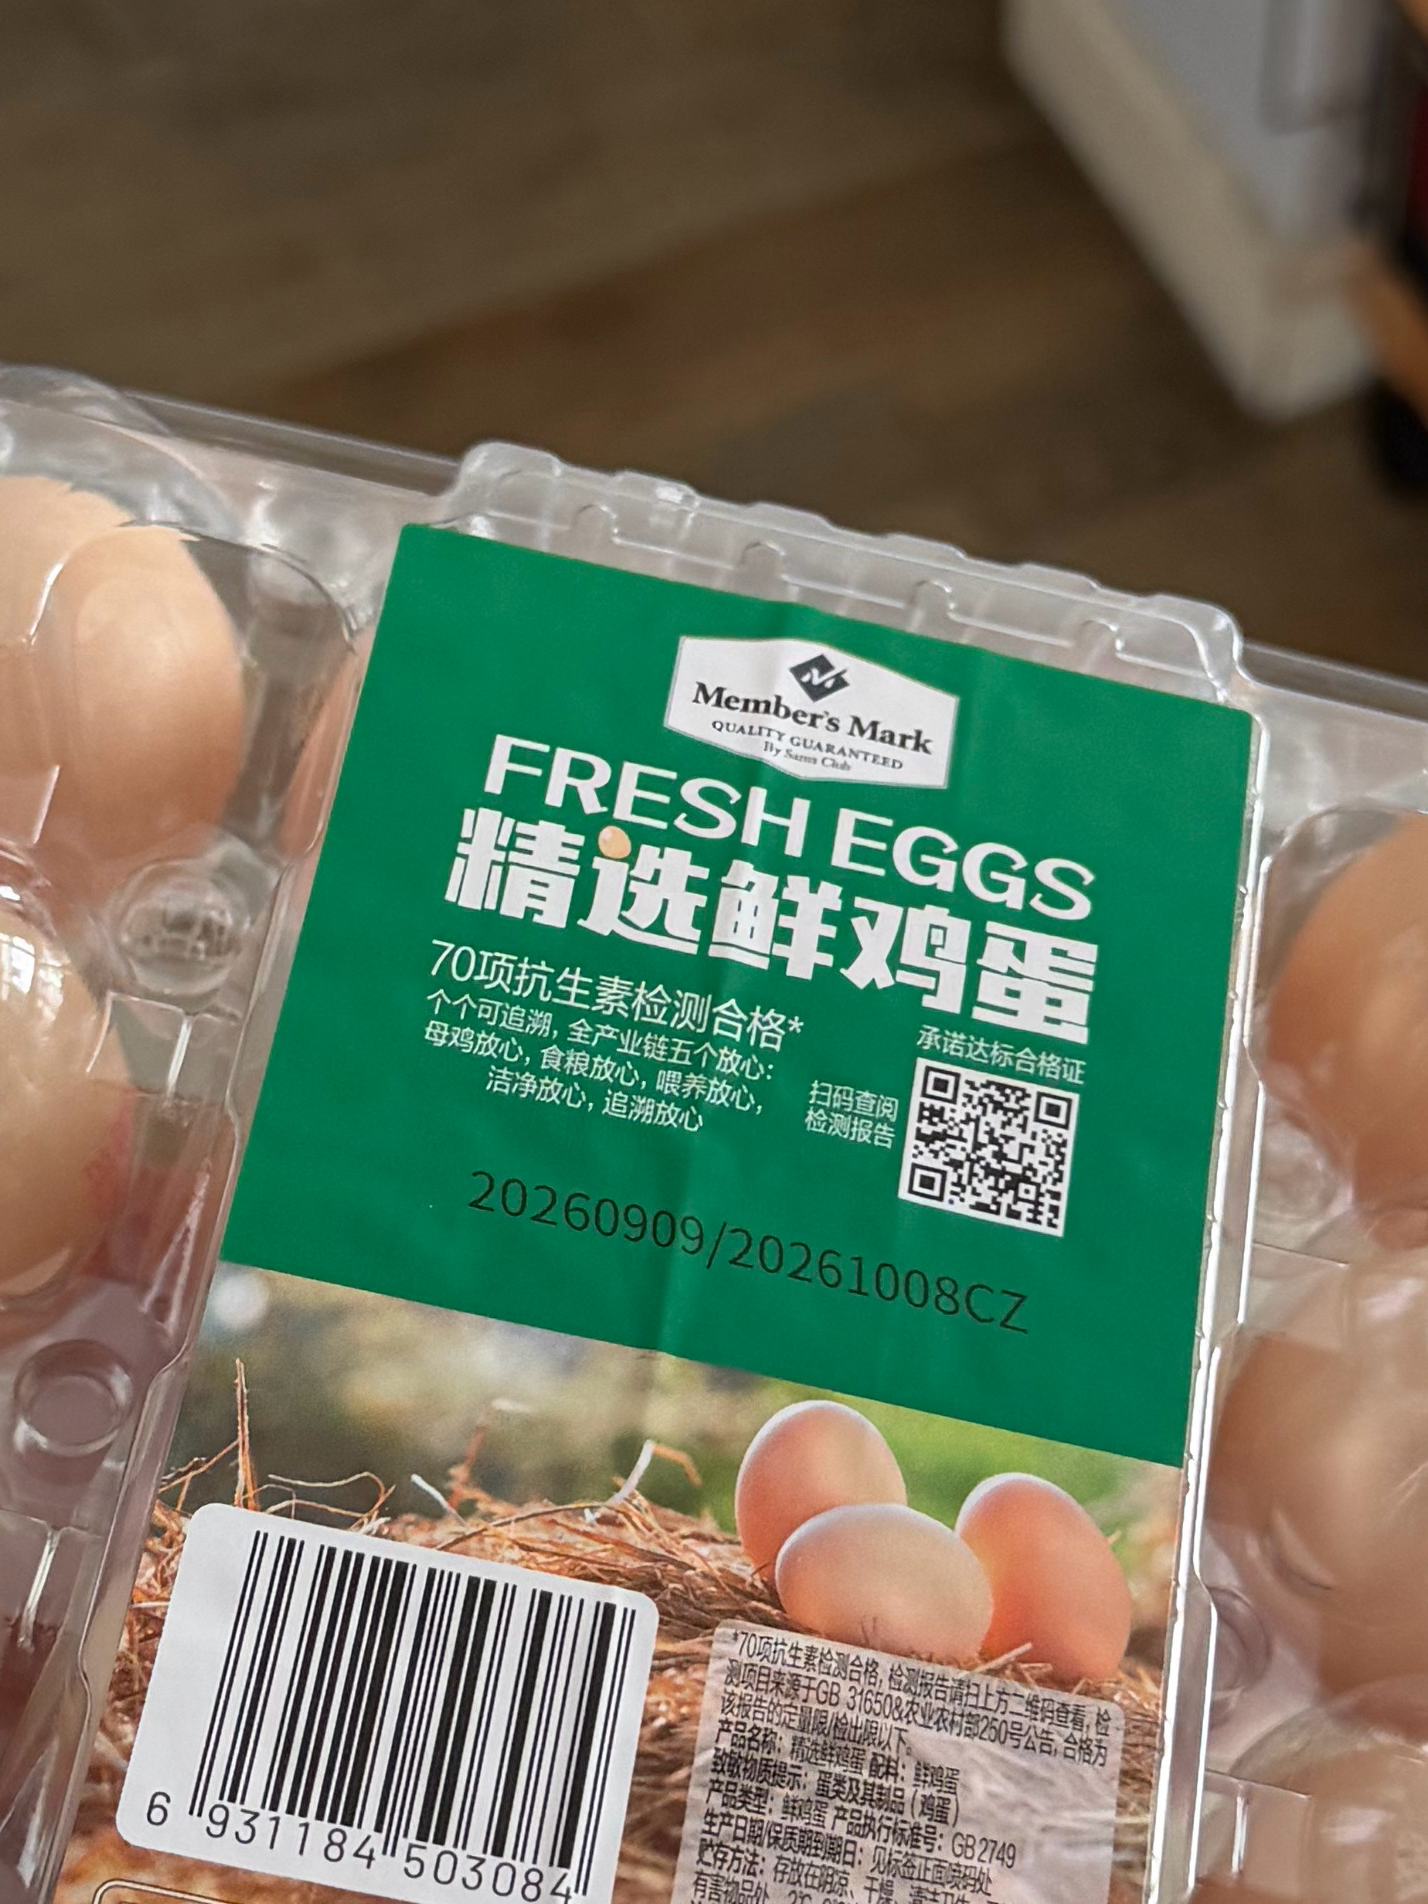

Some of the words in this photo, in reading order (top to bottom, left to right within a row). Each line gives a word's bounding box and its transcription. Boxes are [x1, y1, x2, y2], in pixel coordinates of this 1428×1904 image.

[692, 676, 843, 735] Member's
[847, 714, 935, 755] Mark
[711, 715, 787, 746] QUALITY
[788, 735, 904, 771] GUARANTEED
[483, 730, 810, 861] FRESH
[829, 806, 1097, 926] EGGS
[442, 796, 1100, 1045] 精选鲜鸡蛋
[915, 1022, 1086, 1087] 承诺达标合格证
[803, 1107, 896, 1150] 检测报告
[808, 1079, 899, 1123] 扫码查阅
[462, 1167, 1032, 1336] 20260909/20261008CZ
[144, 1789, 172, 1827] 6
[203, 1800, 379, 1873] 931184
